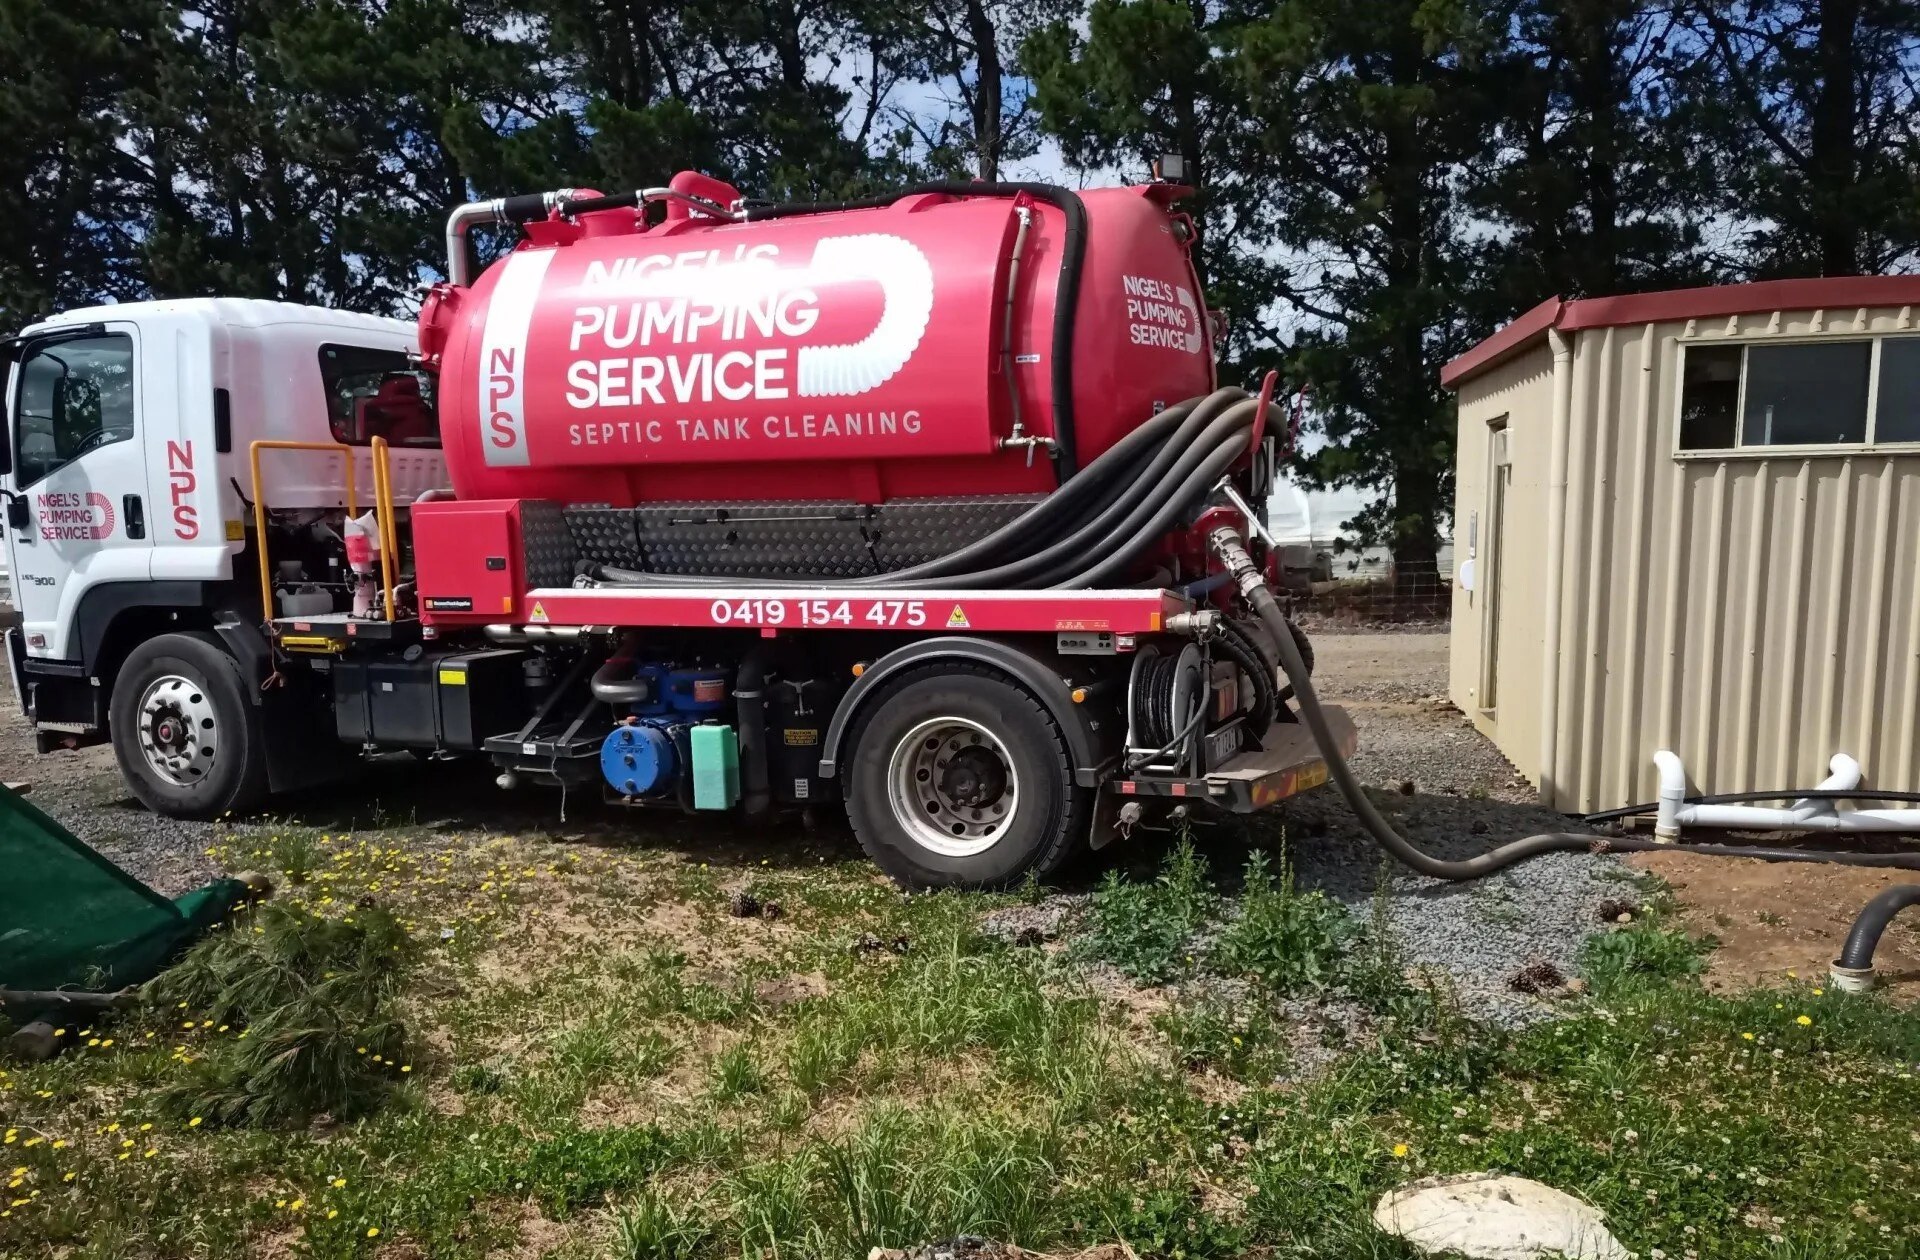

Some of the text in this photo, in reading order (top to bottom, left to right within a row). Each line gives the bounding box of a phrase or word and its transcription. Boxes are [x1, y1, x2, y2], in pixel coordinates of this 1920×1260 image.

[1123, 275, 1173, 302] NIGEL'S
[569, 287, 820, 352] PUMPING
[1128, 299, 1186, 328] PUMPING
[1131, 324, 1186, 350] SERVICE
[565, 347, 788, 410] SERVICE
[489, 347, 517, 449] NPS
[569, 410, 922, 446] SEPTIC TANK CLEANING
[38, 492, 80, 507] NIGEL'S
[167, 440, 200, 540] NPS
[40, 509, 93, 524] PUMPING
[41, 526, 89, 540] SERVICE
[710, 600, 926, 625] 0419 154 475
